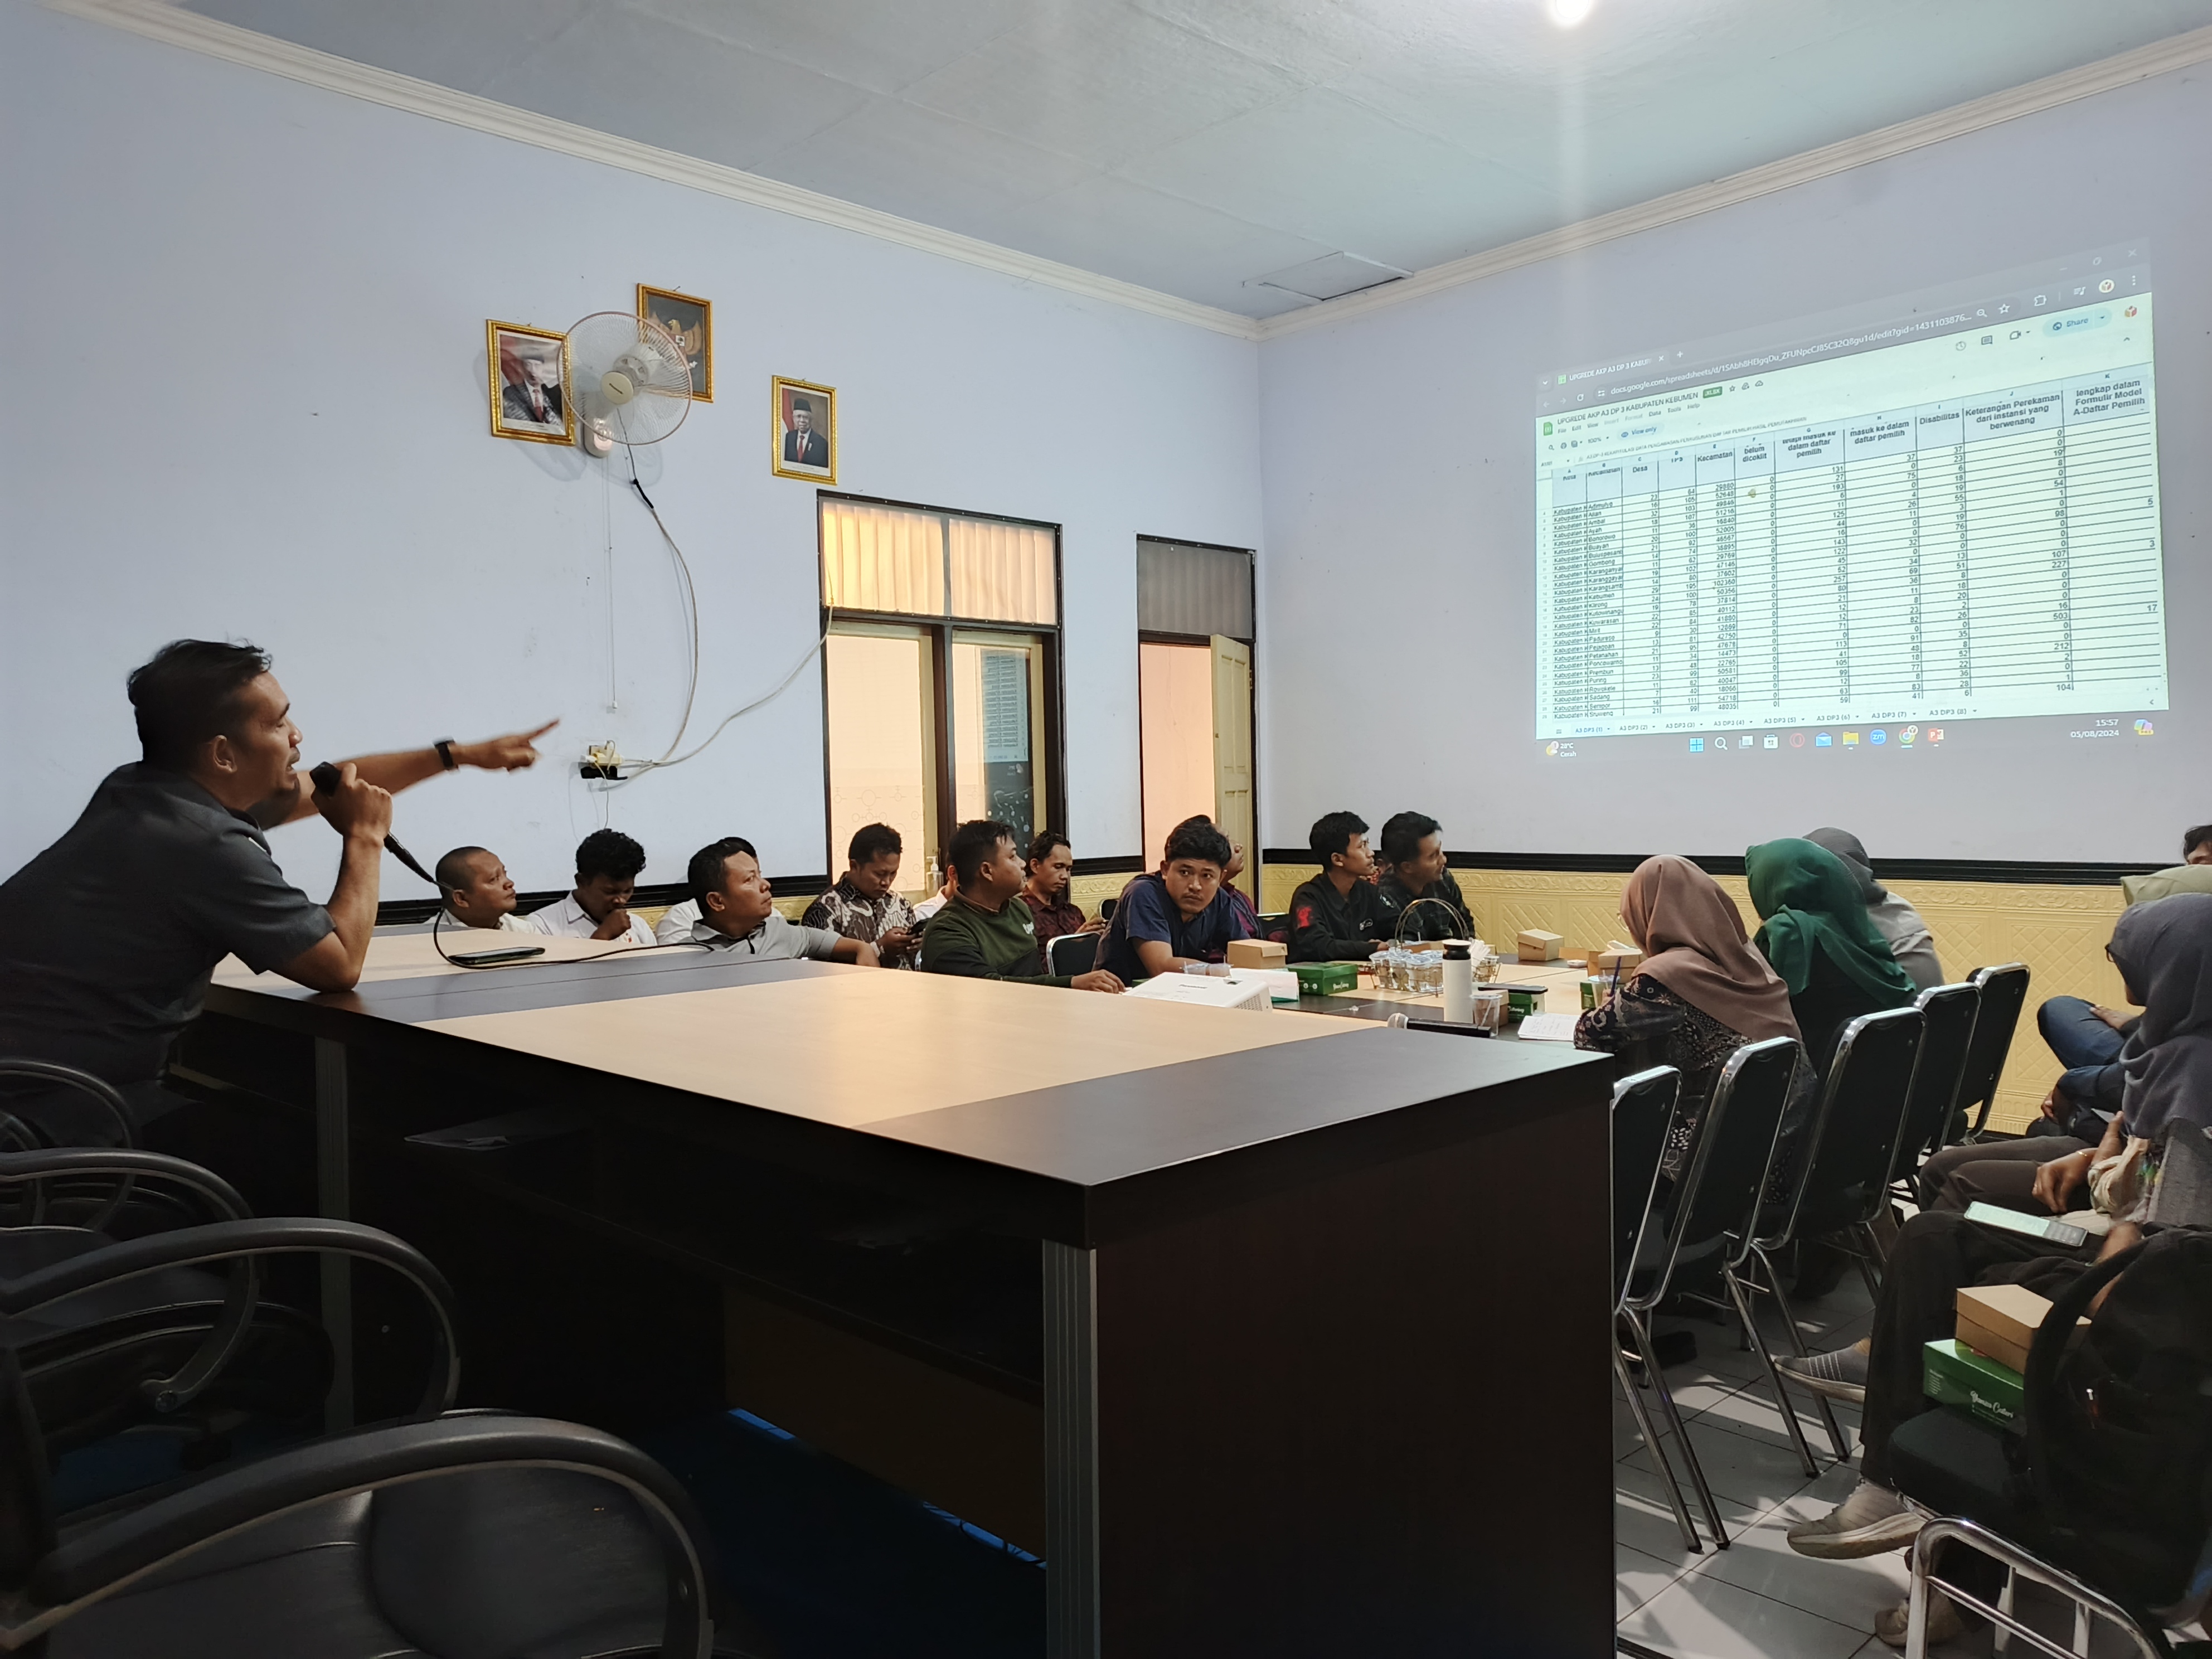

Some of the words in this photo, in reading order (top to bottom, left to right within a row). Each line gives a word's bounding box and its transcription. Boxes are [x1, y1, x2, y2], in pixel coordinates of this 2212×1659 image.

[2067, 316, 2089, 328] Share
[1608, 365, 1616, 373] A3
[2076, 384, 2111, 397] lengkap
[2113, 379, 2141, 391] dalam
[2075, 392, 2112, 406] Formulir
[2114, 387, 2142, 399] Model
[1557, 413, 1586, 426] UPGREDE
[1587, 410, 1600, 420] AKP
[1601, 409, 1609, 417] A3
[1611, 406, 1619, 415] DP
[1621, 405, 1624, 414] 3
[1626, 397, 1663, 413] KABUPATEN
[1665, 391, 1698, 405] KEBUMEN
[1667, 405, 1681, 413] Tools
[1687, 401, 1700, 410] Help
[1965, 401, 2011, 418] Keterangan
[2013, 392, 2060, 408] Perekaman
[2073, 402, 2110, 416] A-Daftar
[2111, 396, 2145, 409] Pemilih
[1919, 410, 1959, 425] Disabilitas
[1976, 414, 1991, 423] dari
[1993, 408, 2026, 420] instansi
[2028, 405, 2049, 415] yang
[1850, 426, 1874, 437] masuk
[1875, 424, 1885, 432] ke
[1886, 419, 1909, 430] dalam
[1990, 415, 2035, 430] berwenang
[1631, 428, 1644, 436] View
[1645, 425, 1657, 435] only
[1854, 434, 1876, 444] daftar
[1878, 429, 1905, 442] pemilih
[1744, 444, 1764, 454] belum
[1788, 441, 1808, 451] dalam
[1810, 438, 1831, 448] daftar
[1697, 450, 1733, 462] Kecamatan
[1743, 452, 1767, 463] dicoklit
[1796, 447, 1822, 458] pemilih
[1954, 454, 1963, 463] 23
[1632, 464, 1647, 473] Desa
[1589, 559, 1615, 567] Gombong
[2051, 560, 2067, 568] 227
[2053, 612, 2069, 620] 503
[2095, 719, 2118, 727] 15:57
[2070, 729, 2119, 739] 05/08/2024
